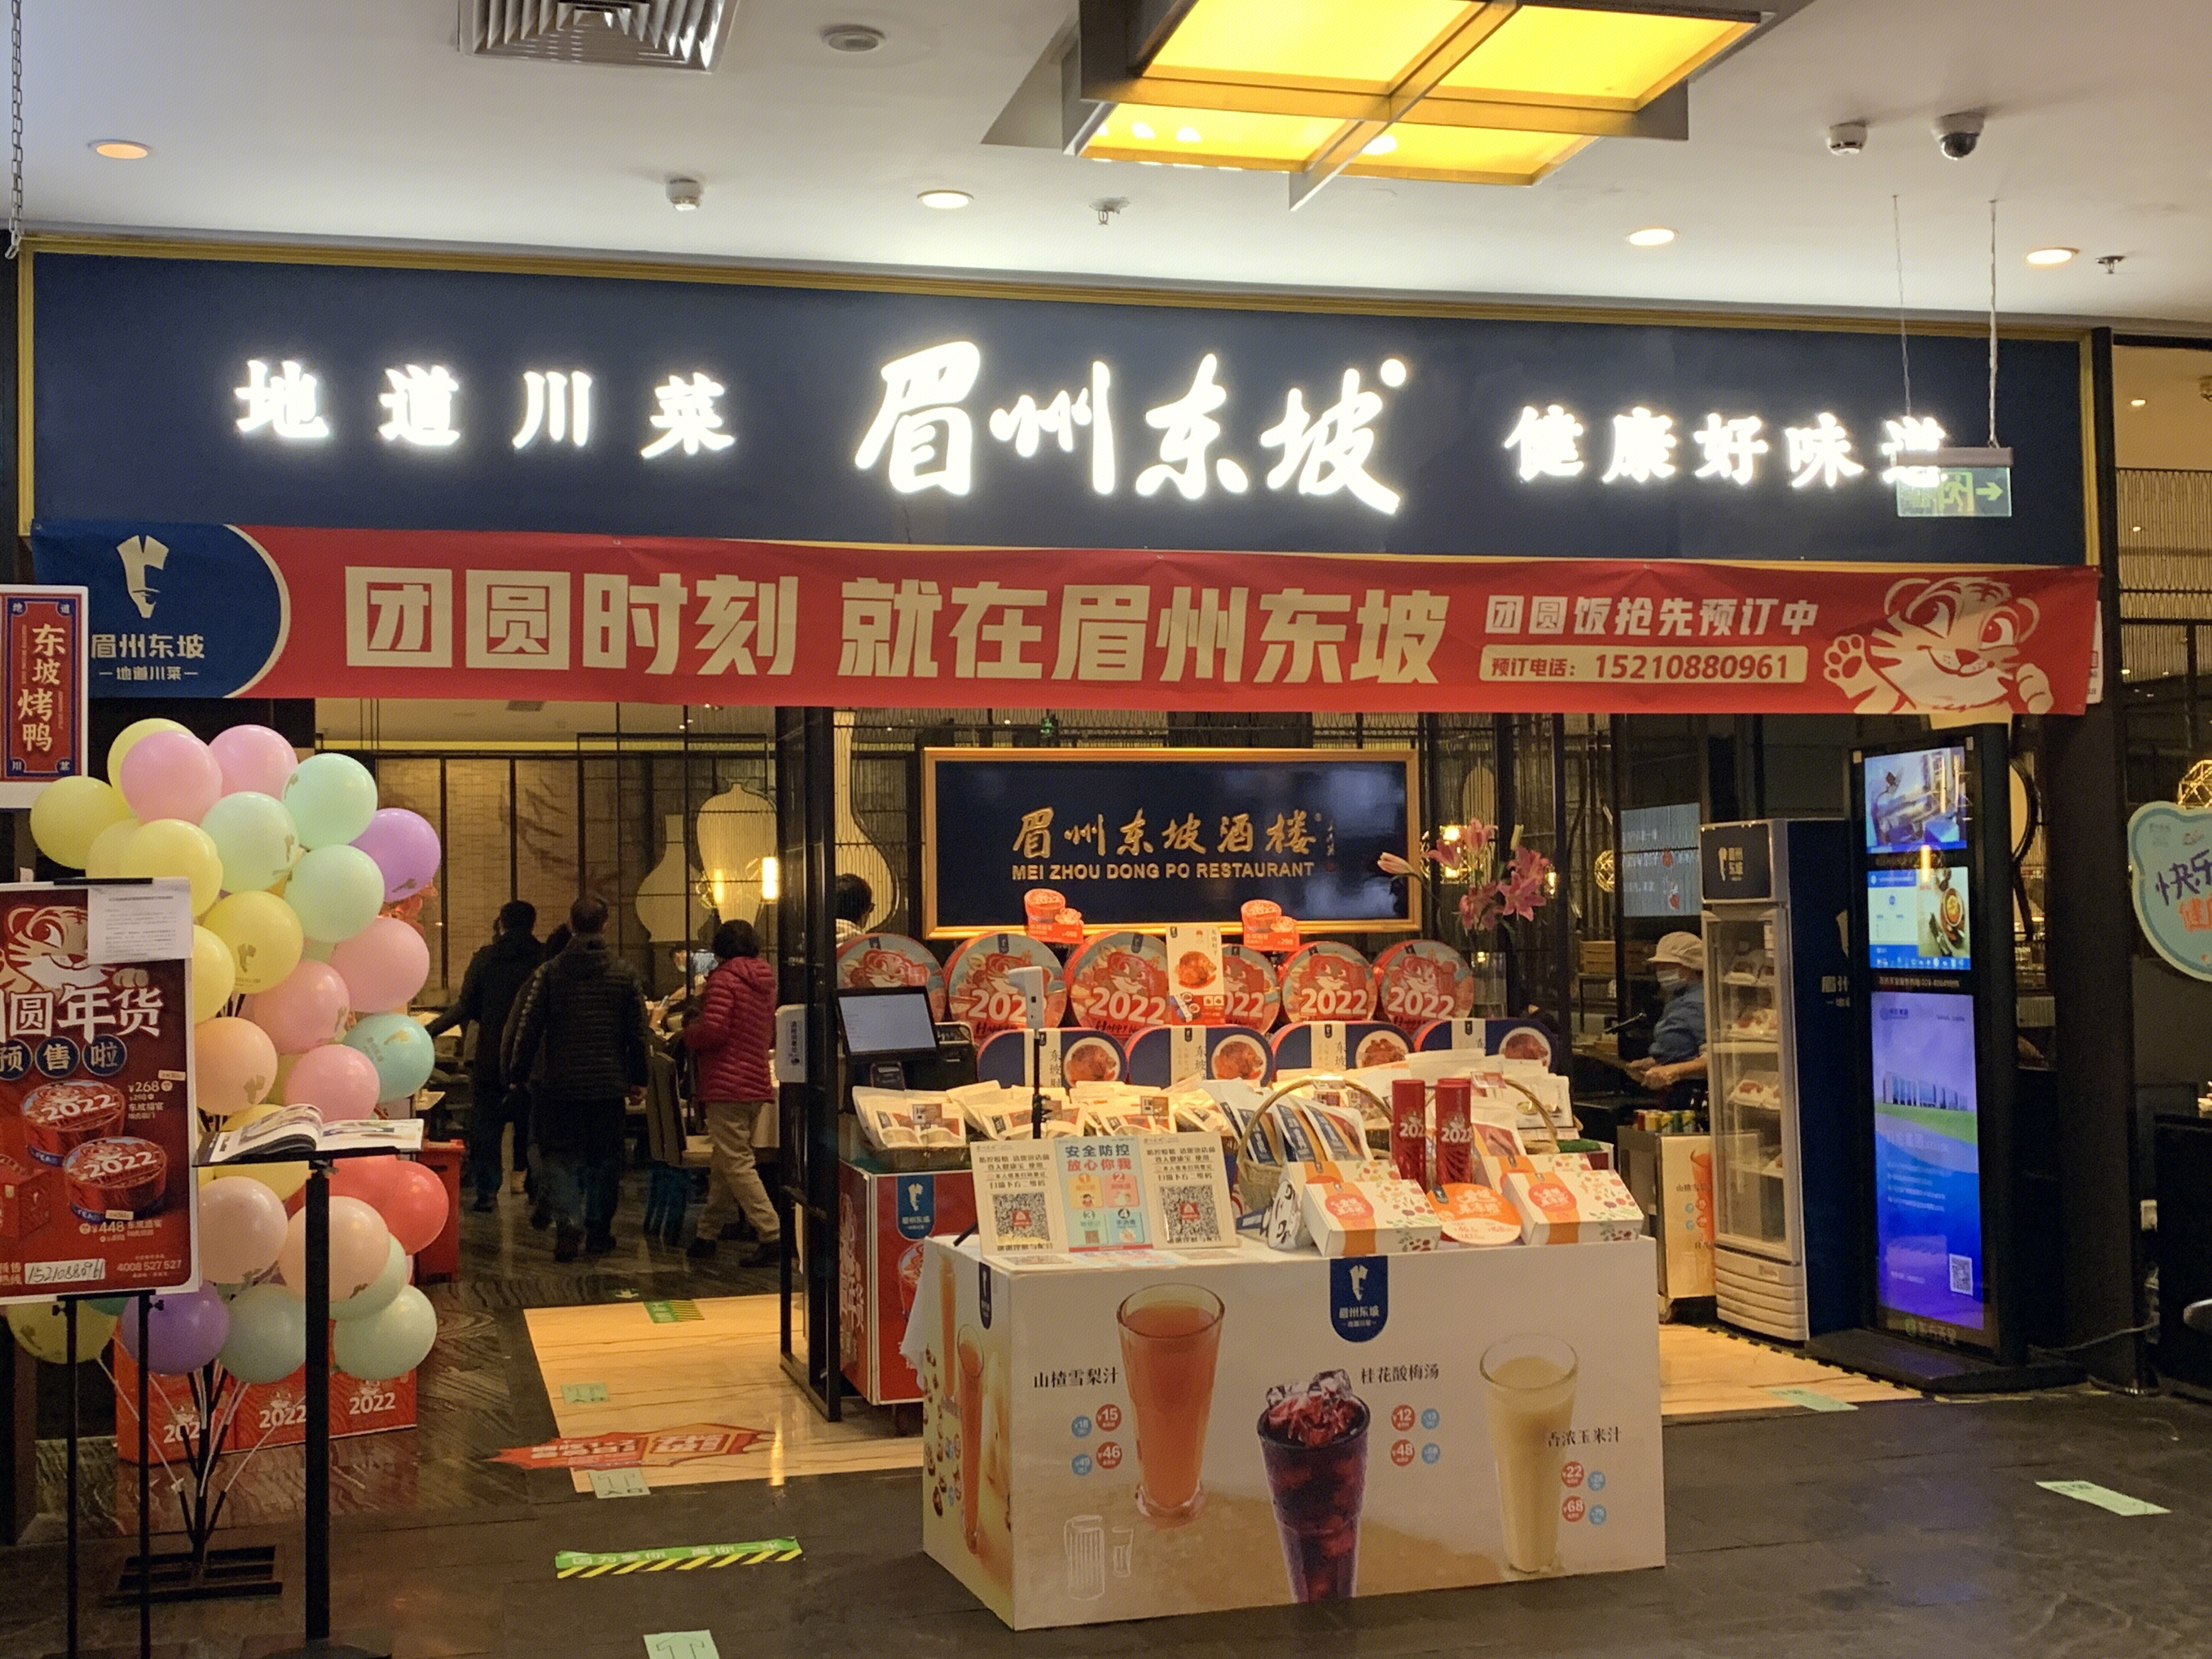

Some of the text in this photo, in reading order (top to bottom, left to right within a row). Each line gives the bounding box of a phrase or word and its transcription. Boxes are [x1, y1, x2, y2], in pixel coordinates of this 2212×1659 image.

[234, 359, 736, 458] 地道川菜
[855, 341, 1401, 514] 眉州东坡
[345, 566, 798, 675] 团圆时刻
[1485, 595, 1819, 636] 团圆饭抢先预订中
[837, 577, 1450, 684] 就在眉州东坡
[91, 633, 205, 659] 眉州东坡
[1595, 653, 1787, 680] 15210880961
[18, 623, 66, 752] 东坡烤鸭
[1012, 807, 1316, 859] 眉州东坡酒楼
[1012, 861, 1314, 881] MEI ZHOU DONG PO RESTAURANT
[1088, 987, 1166, 1025] 2022
[1301, 988, 1368, 1014] 2022
[1387, 986, 1455, 1019] 2022
[0, 986, 163, 1045] 圆年货
[40, 1093, 116, 1121] 2022
[83, 1151, 158, 1178] 2022
[1065, 1144, 1130, 1158] 安全防控
[1067, 1158, 1132, 1172] 放心你我
[1034, 1366, 1119, 1389] 山楂雪梨汁
[1362, 1363, 1439, 1384] 桂花酸梅汤
[259, 1405, 306, 1429] 2022
[348, 1392, 396, 1415] 2022
